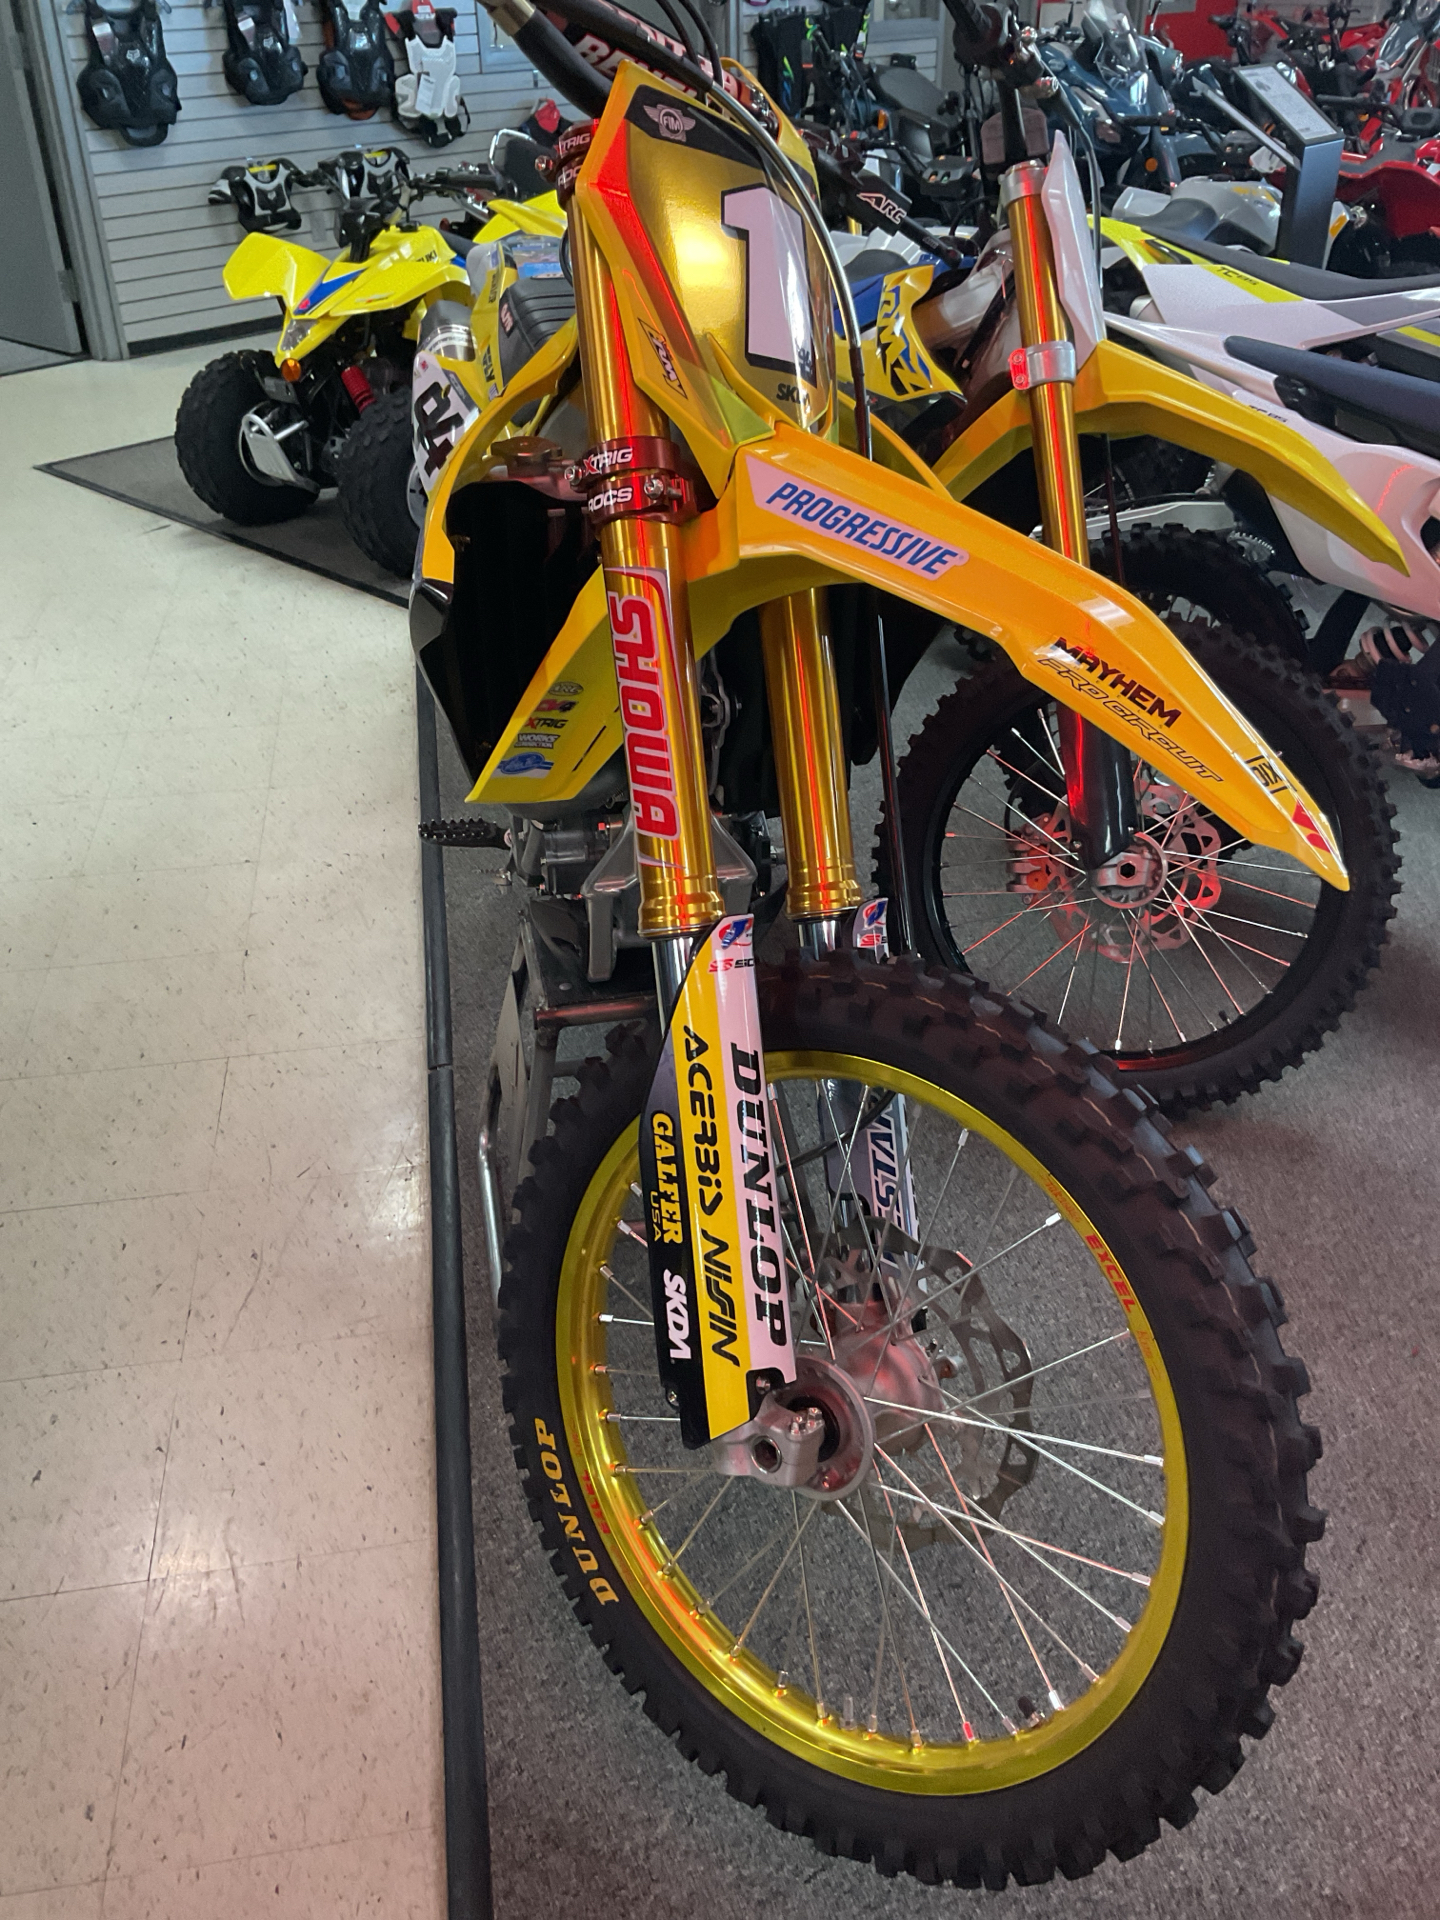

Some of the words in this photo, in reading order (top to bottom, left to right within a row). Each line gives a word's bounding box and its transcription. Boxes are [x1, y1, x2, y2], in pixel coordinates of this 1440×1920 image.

[857, 193, 907, 224] ARC
[721, 183, 816, 384] 1
[583, 447, 633, 476] XTRIG
[765, 482, 958, 575] PROGRESSIVE
[524, 717, 569, 729] XTRIG
[608, 591, 680, 841] SHOWA
[1037, 658, 1109, 700] PRO
[1102, 700, 1223, 783] CIRCUIT
[1053, 637, 1182, 729] MAYHEM
[650, 1191, 661, 1242] USA
[652, 1111, 683, 1244] GALFER
[730, 1042, 788, 1347] DUNLOP
[1084, 1233, 1137, 1314] EXCEL
[534, 1417, 620, 1606] DUNLOP
